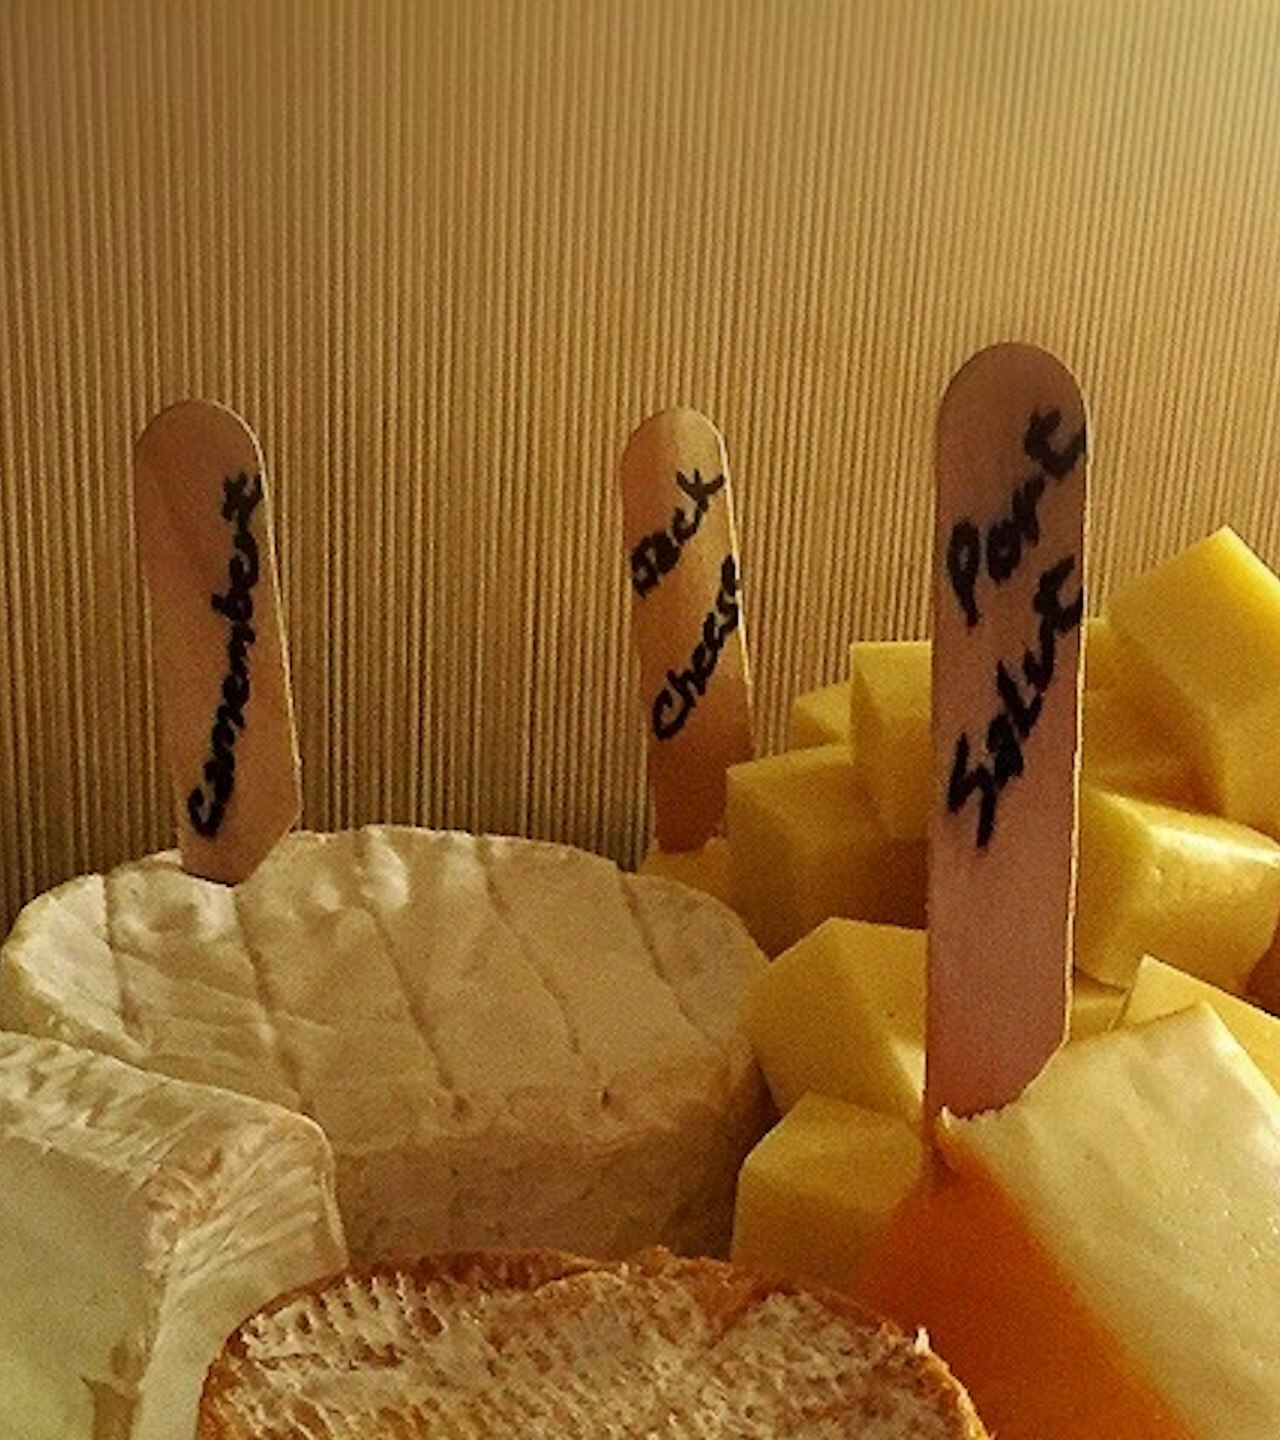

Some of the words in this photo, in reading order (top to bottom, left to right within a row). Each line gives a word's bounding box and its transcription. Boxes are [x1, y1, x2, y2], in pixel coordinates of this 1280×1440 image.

[946, 406, 1087, 630] Port
[651, 553, 740, 741] Cheese
[945, 552, 1085, 852] Salut
